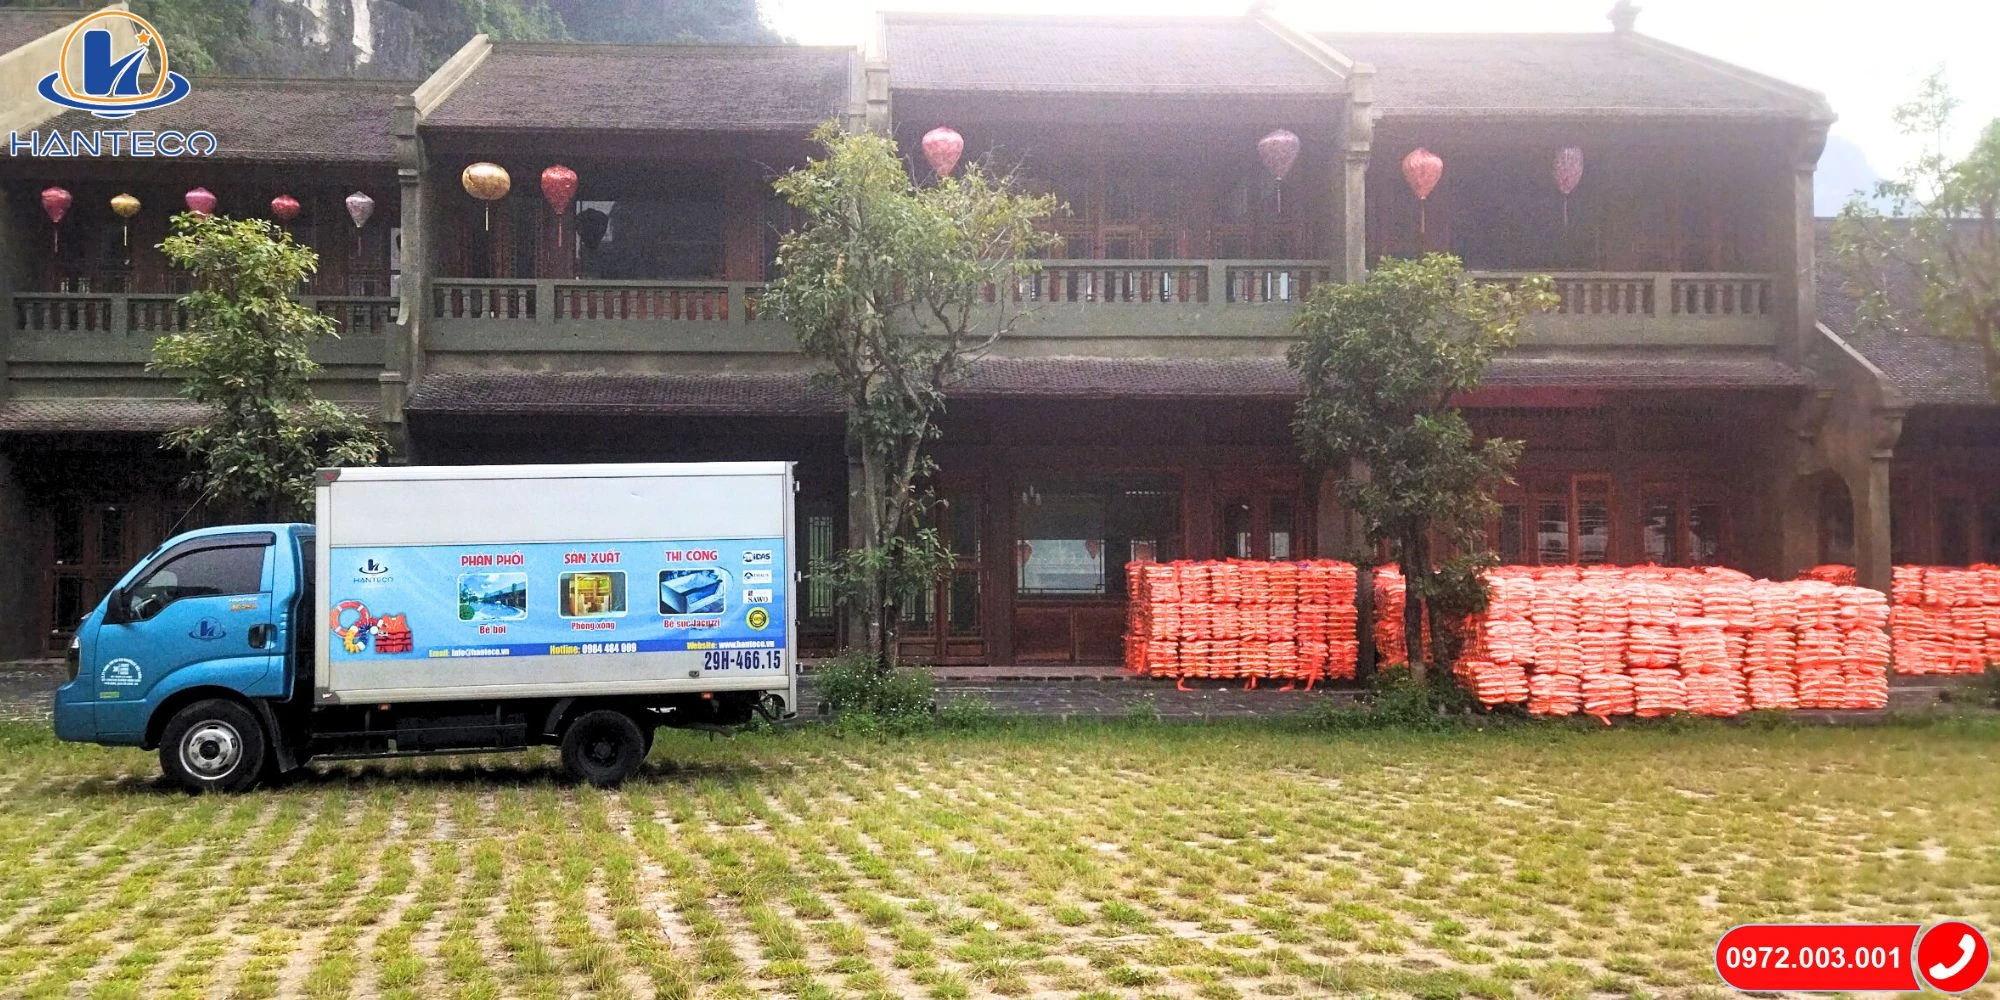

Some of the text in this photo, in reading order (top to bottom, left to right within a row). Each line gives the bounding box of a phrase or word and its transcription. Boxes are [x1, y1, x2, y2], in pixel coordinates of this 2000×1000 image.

[666, 551, 682, 561] THI
[549, 645, 580, 655] Hotline:
[581, 644, 603, 654] 0984
[603, 643, 620, 653] 484
[687, 640, 775, 649] Website: www.hanteco.vn
[704, 651, 781, 671] 29H-466.15
